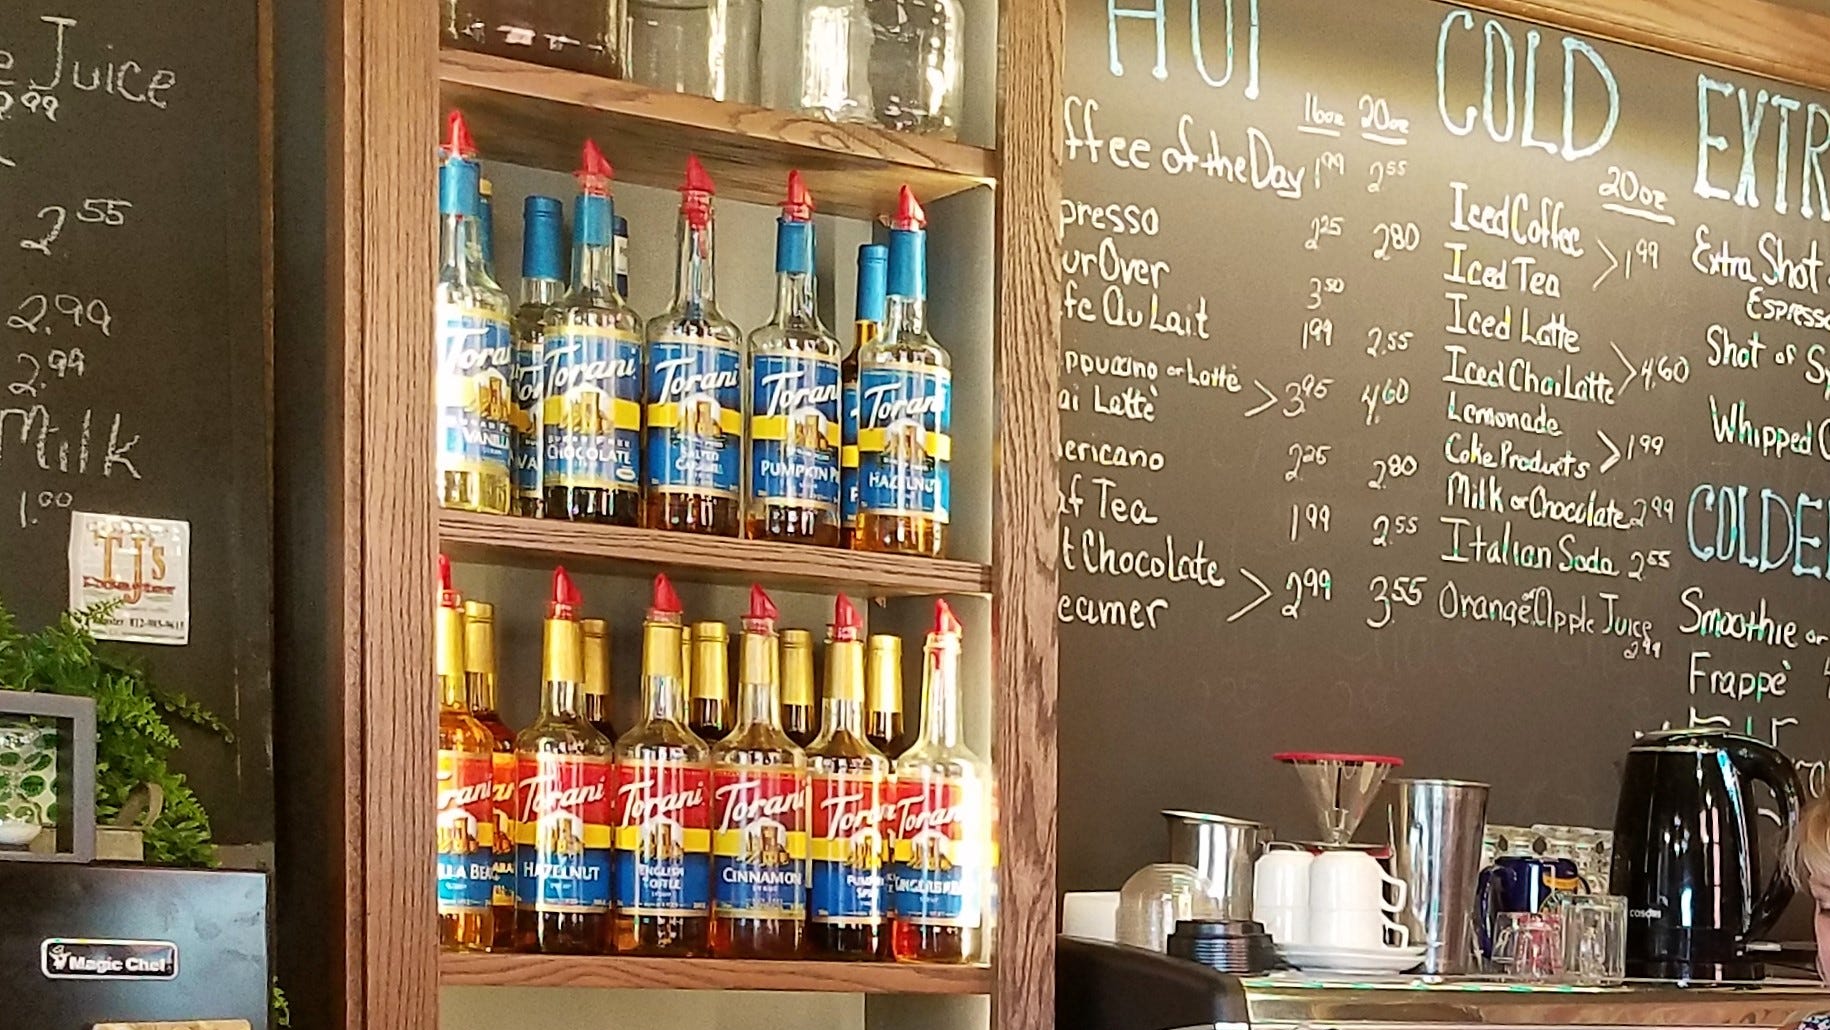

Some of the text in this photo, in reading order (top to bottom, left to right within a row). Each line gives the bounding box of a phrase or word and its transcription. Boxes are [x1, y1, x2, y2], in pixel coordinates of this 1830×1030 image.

[29, 16, 176, 109] Juice
[1437, 10, 1620, 162] COLD
[1063, 95, 1152, 171] ffee
[1247, 126, 1306, 199] Day
[1059, 198, 1161, 241] presso
[1443, 242, 1561, 299] Iced Tea
[1691, 223, 1758, 283] Extra
[1757, 231, 1826, 295] Shot
[1149, 292, 1210, 340] Lait
[1444, 292, 1512, 342] Iced
[544, 343, 637, 396] Torani
[1442, 344, 1505, 389] Iced
[1705, 323, 1768, 370] Shot
[1774, 343, 1799, 367] of
[654, 356, 739, 406] Torani
[1447, 390, 1564, 438] Lemonade
[1708, 394, 1814, 459] Whipped
[1059, 439, 1166, 471] ericano
[1500, 439, 1591, 481] Products
[1091, 477, 1160, 526] Tea
[1447, 470, 1504, 514] Milk
[1529, 484, 1631, 530] Chocolate
[1081, 529, 1227, 588] Chocolate
[1440, 515, 1553, 570] Italian
[1557, 532, 1621, 578] Soda
[1057, 594, 1170, 630] eamer
[1599, 591, 1654, 640] Juice
[1678, 585, 1830, 650] Smoothie or
[618, 779, 704, 831] Torani
[715, 779, 807, 836] Torani
[522, 861, 601, 882] HAZELNUT
[722, 866, 803, 887] CINNAMON
[69, 955, 166, 974] Magic Chef
